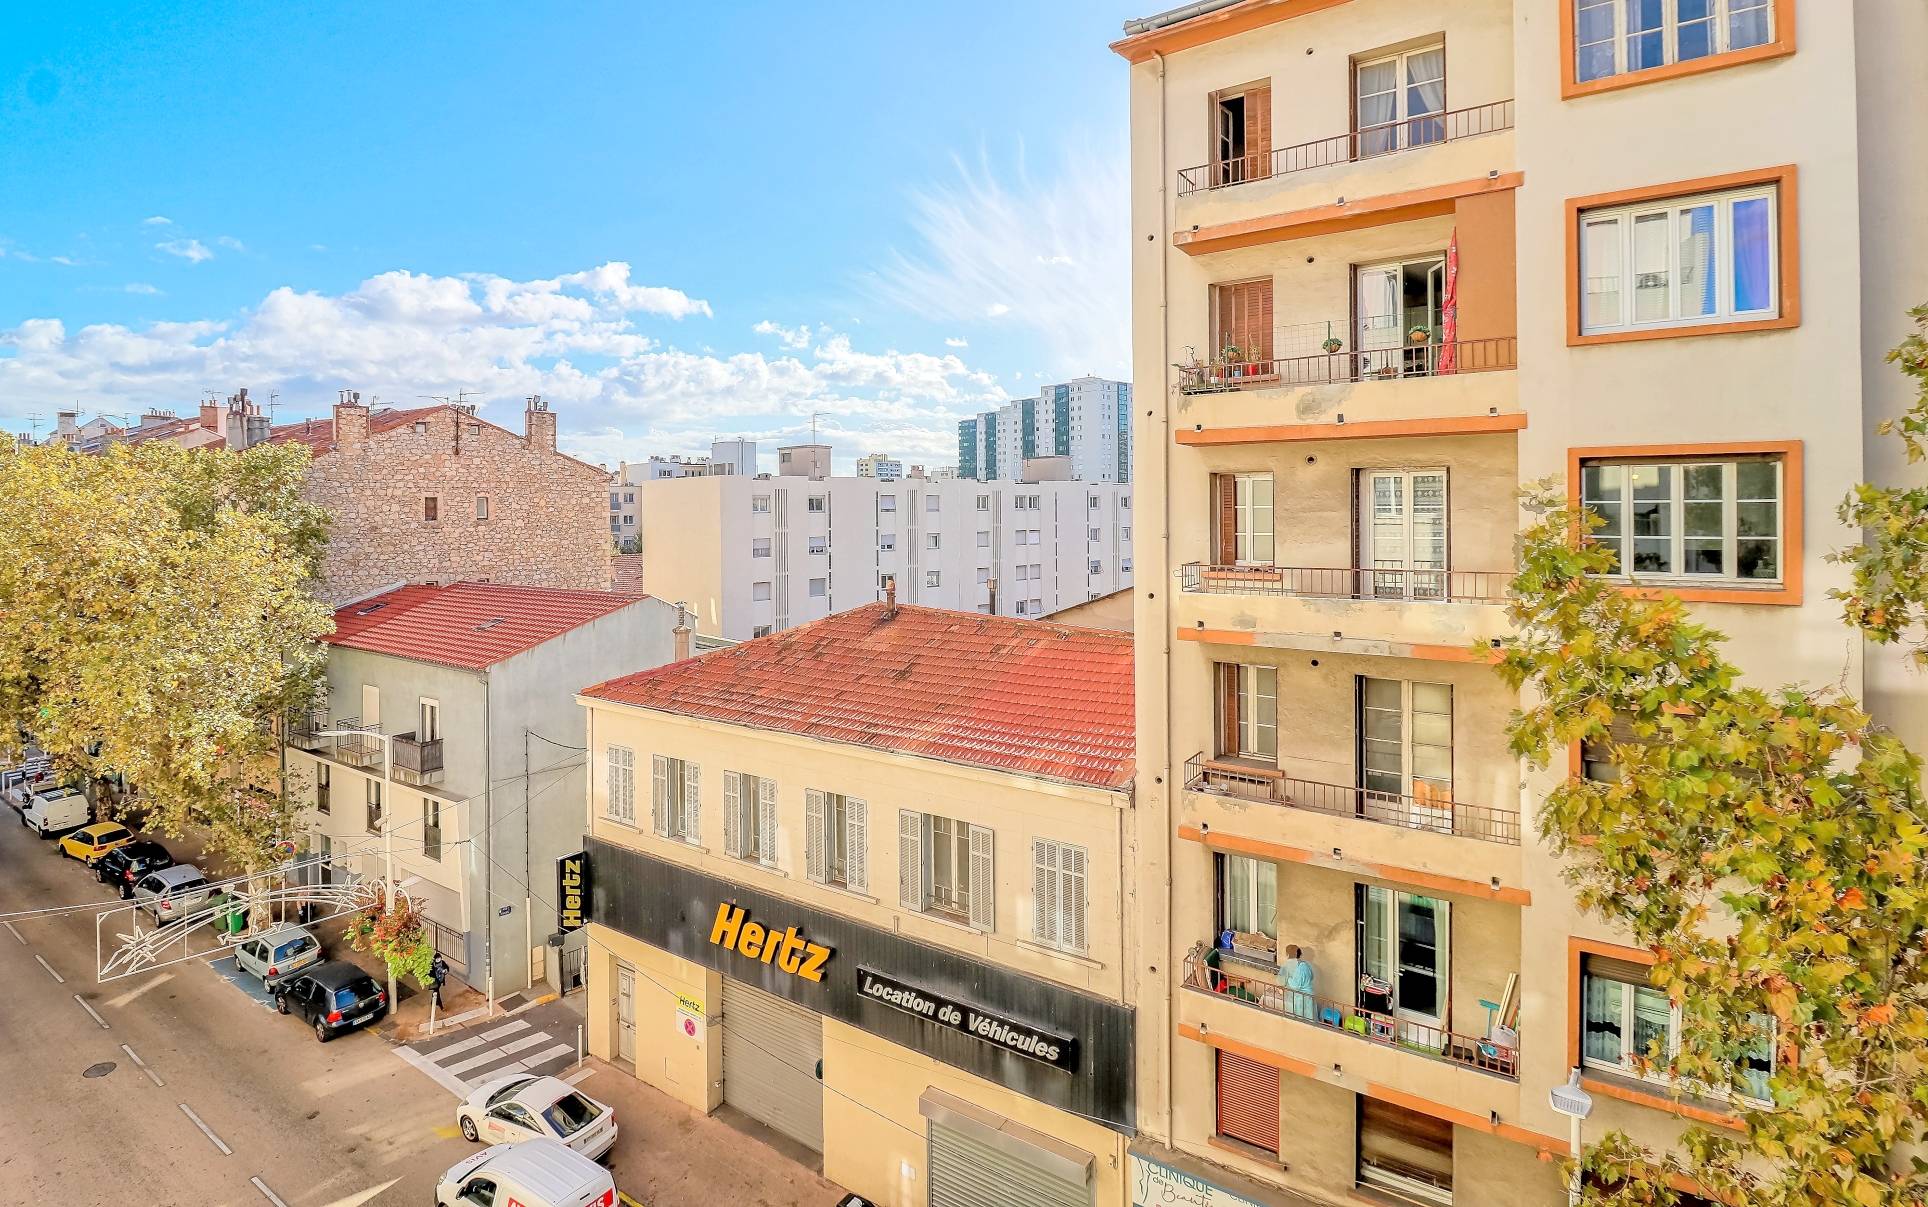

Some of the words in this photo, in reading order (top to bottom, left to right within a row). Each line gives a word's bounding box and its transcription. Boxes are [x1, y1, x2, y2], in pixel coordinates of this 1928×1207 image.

[563, 860, 581, 926] Hertz
[710, 902, 831, 982] Hertz
[679, 996, 700, 1012] Hertz
[863, 976, 935, 1016] Location
[938, 1005, 962, 1025] de
[968, 1012, 1060, 1061] Véhicules
[1148, 1162, 1213, 1197] CLINIQUE
